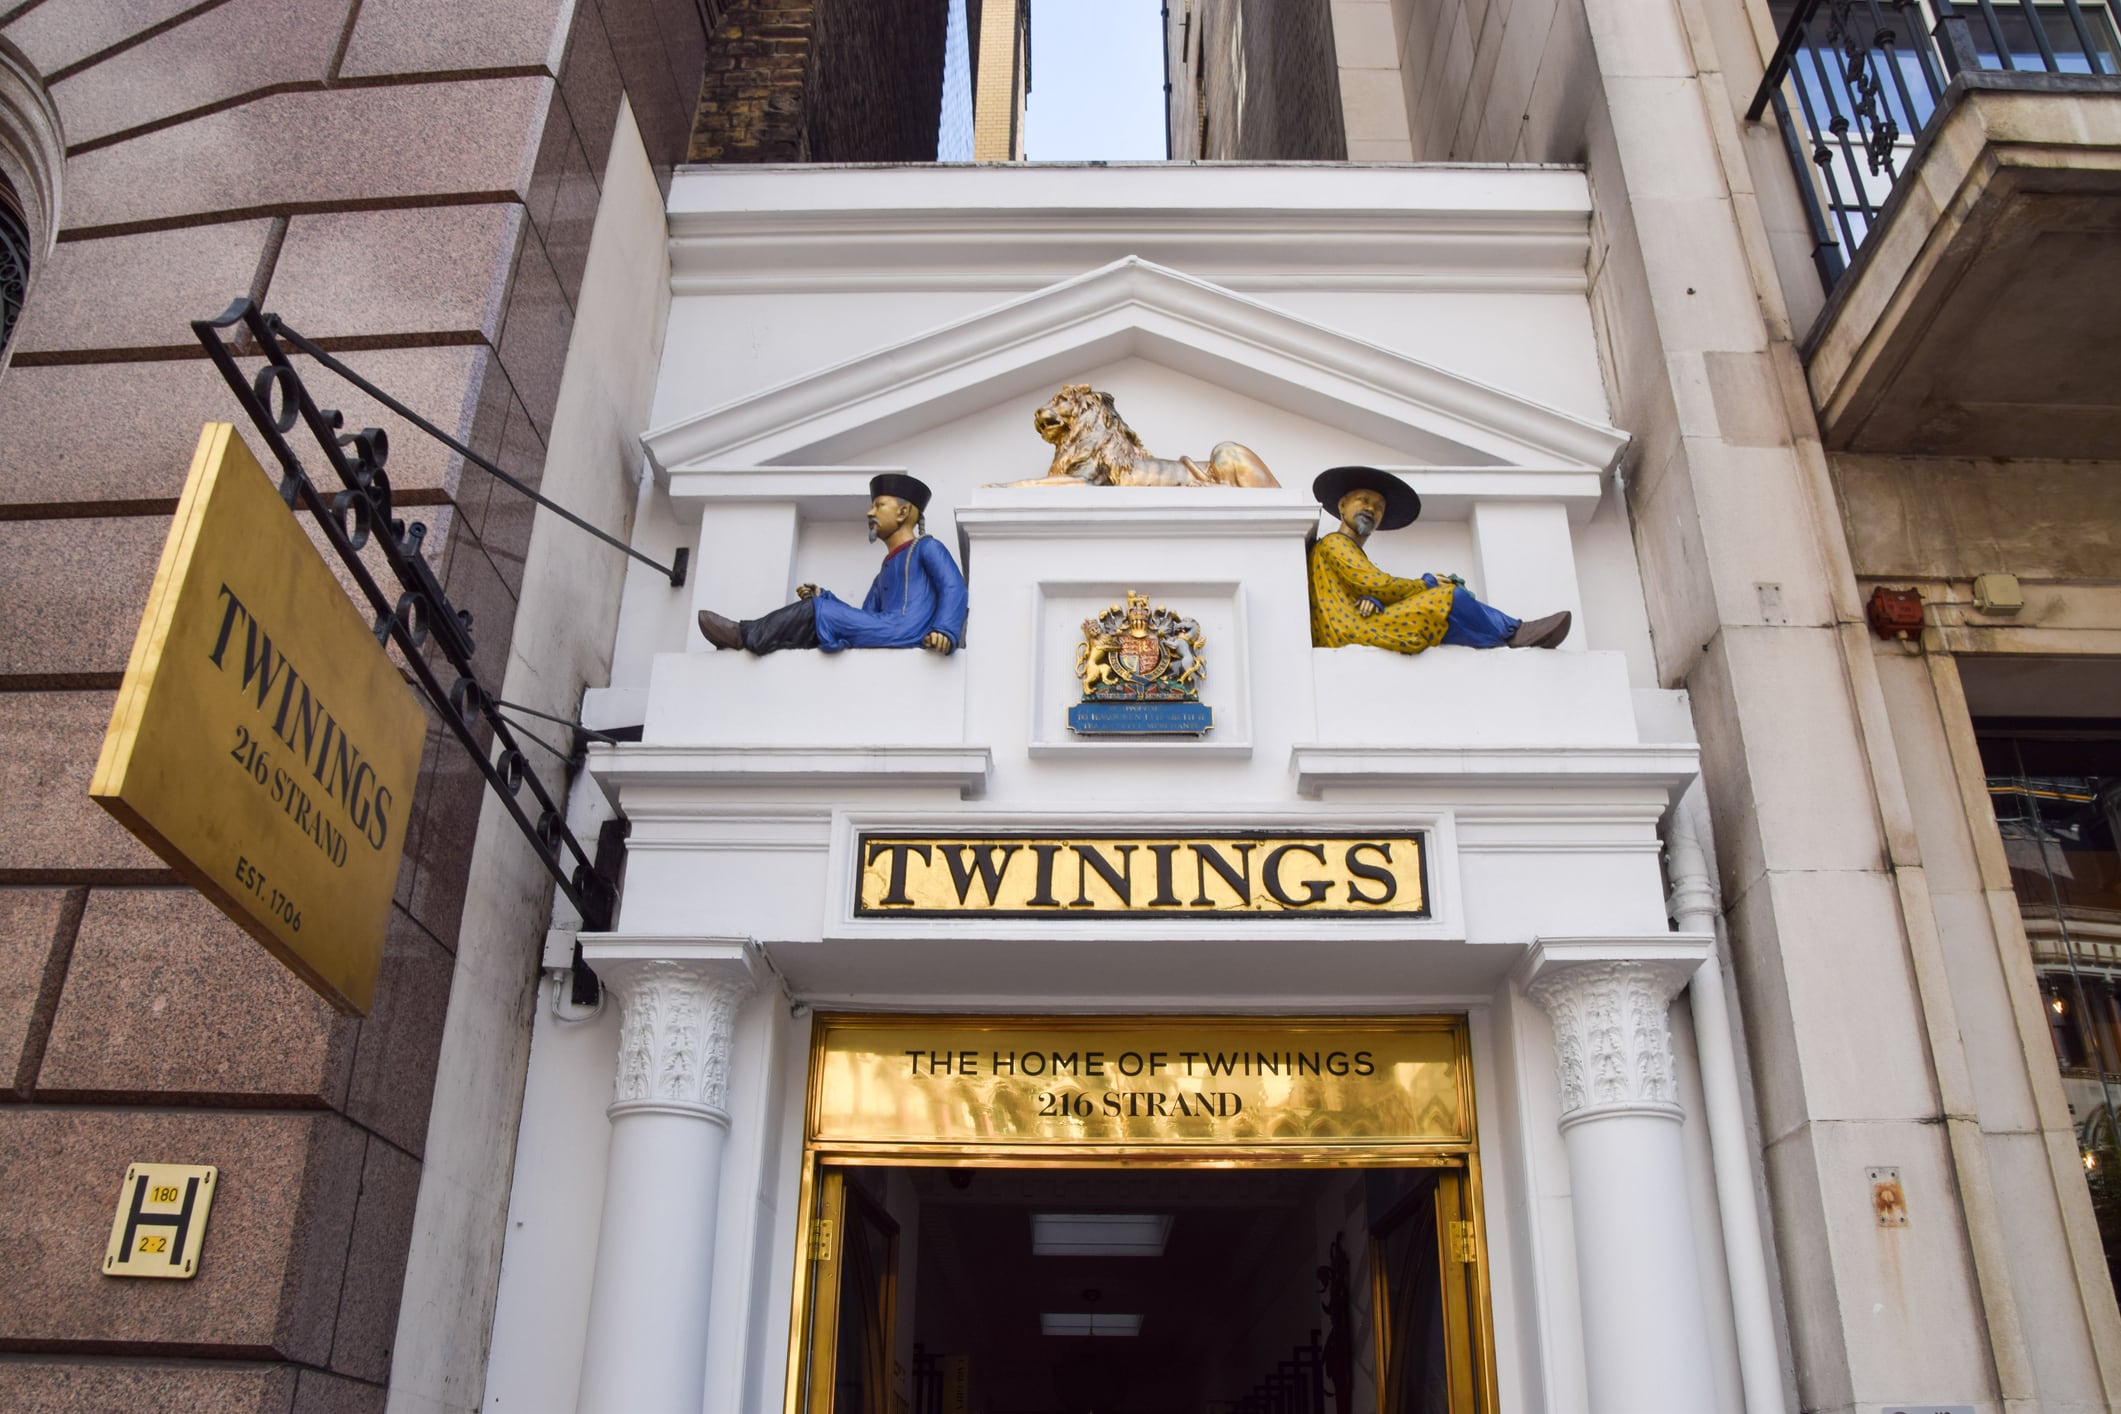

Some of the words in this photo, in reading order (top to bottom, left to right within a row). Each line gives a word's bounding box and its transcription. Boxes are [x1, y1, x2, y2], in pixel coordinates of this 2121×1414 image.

[208, 582, 393, 851] TWININGS
[230, 724, 269, 786] 216
[270, 767, 348, 869] STRAND
[235, 855, 267, 901] EST.
[270, 888, 302, 933] 1706
[867, 843, 1399, 907] TWININGS
[905, 1051, 979, 1075] THE
[992, 1051, 1105, 1076] HOME
[1118, 1051, 1168, 1076] OF
[1179, 1051, 1375, 1076] TWININGS
[1038, 1092, 1094, 1117] 216
[1103, 1091, 1243, 1117] STRAND
[117, 1175, 200, 1265] H
[152, 1187, 178, 1202] 180
